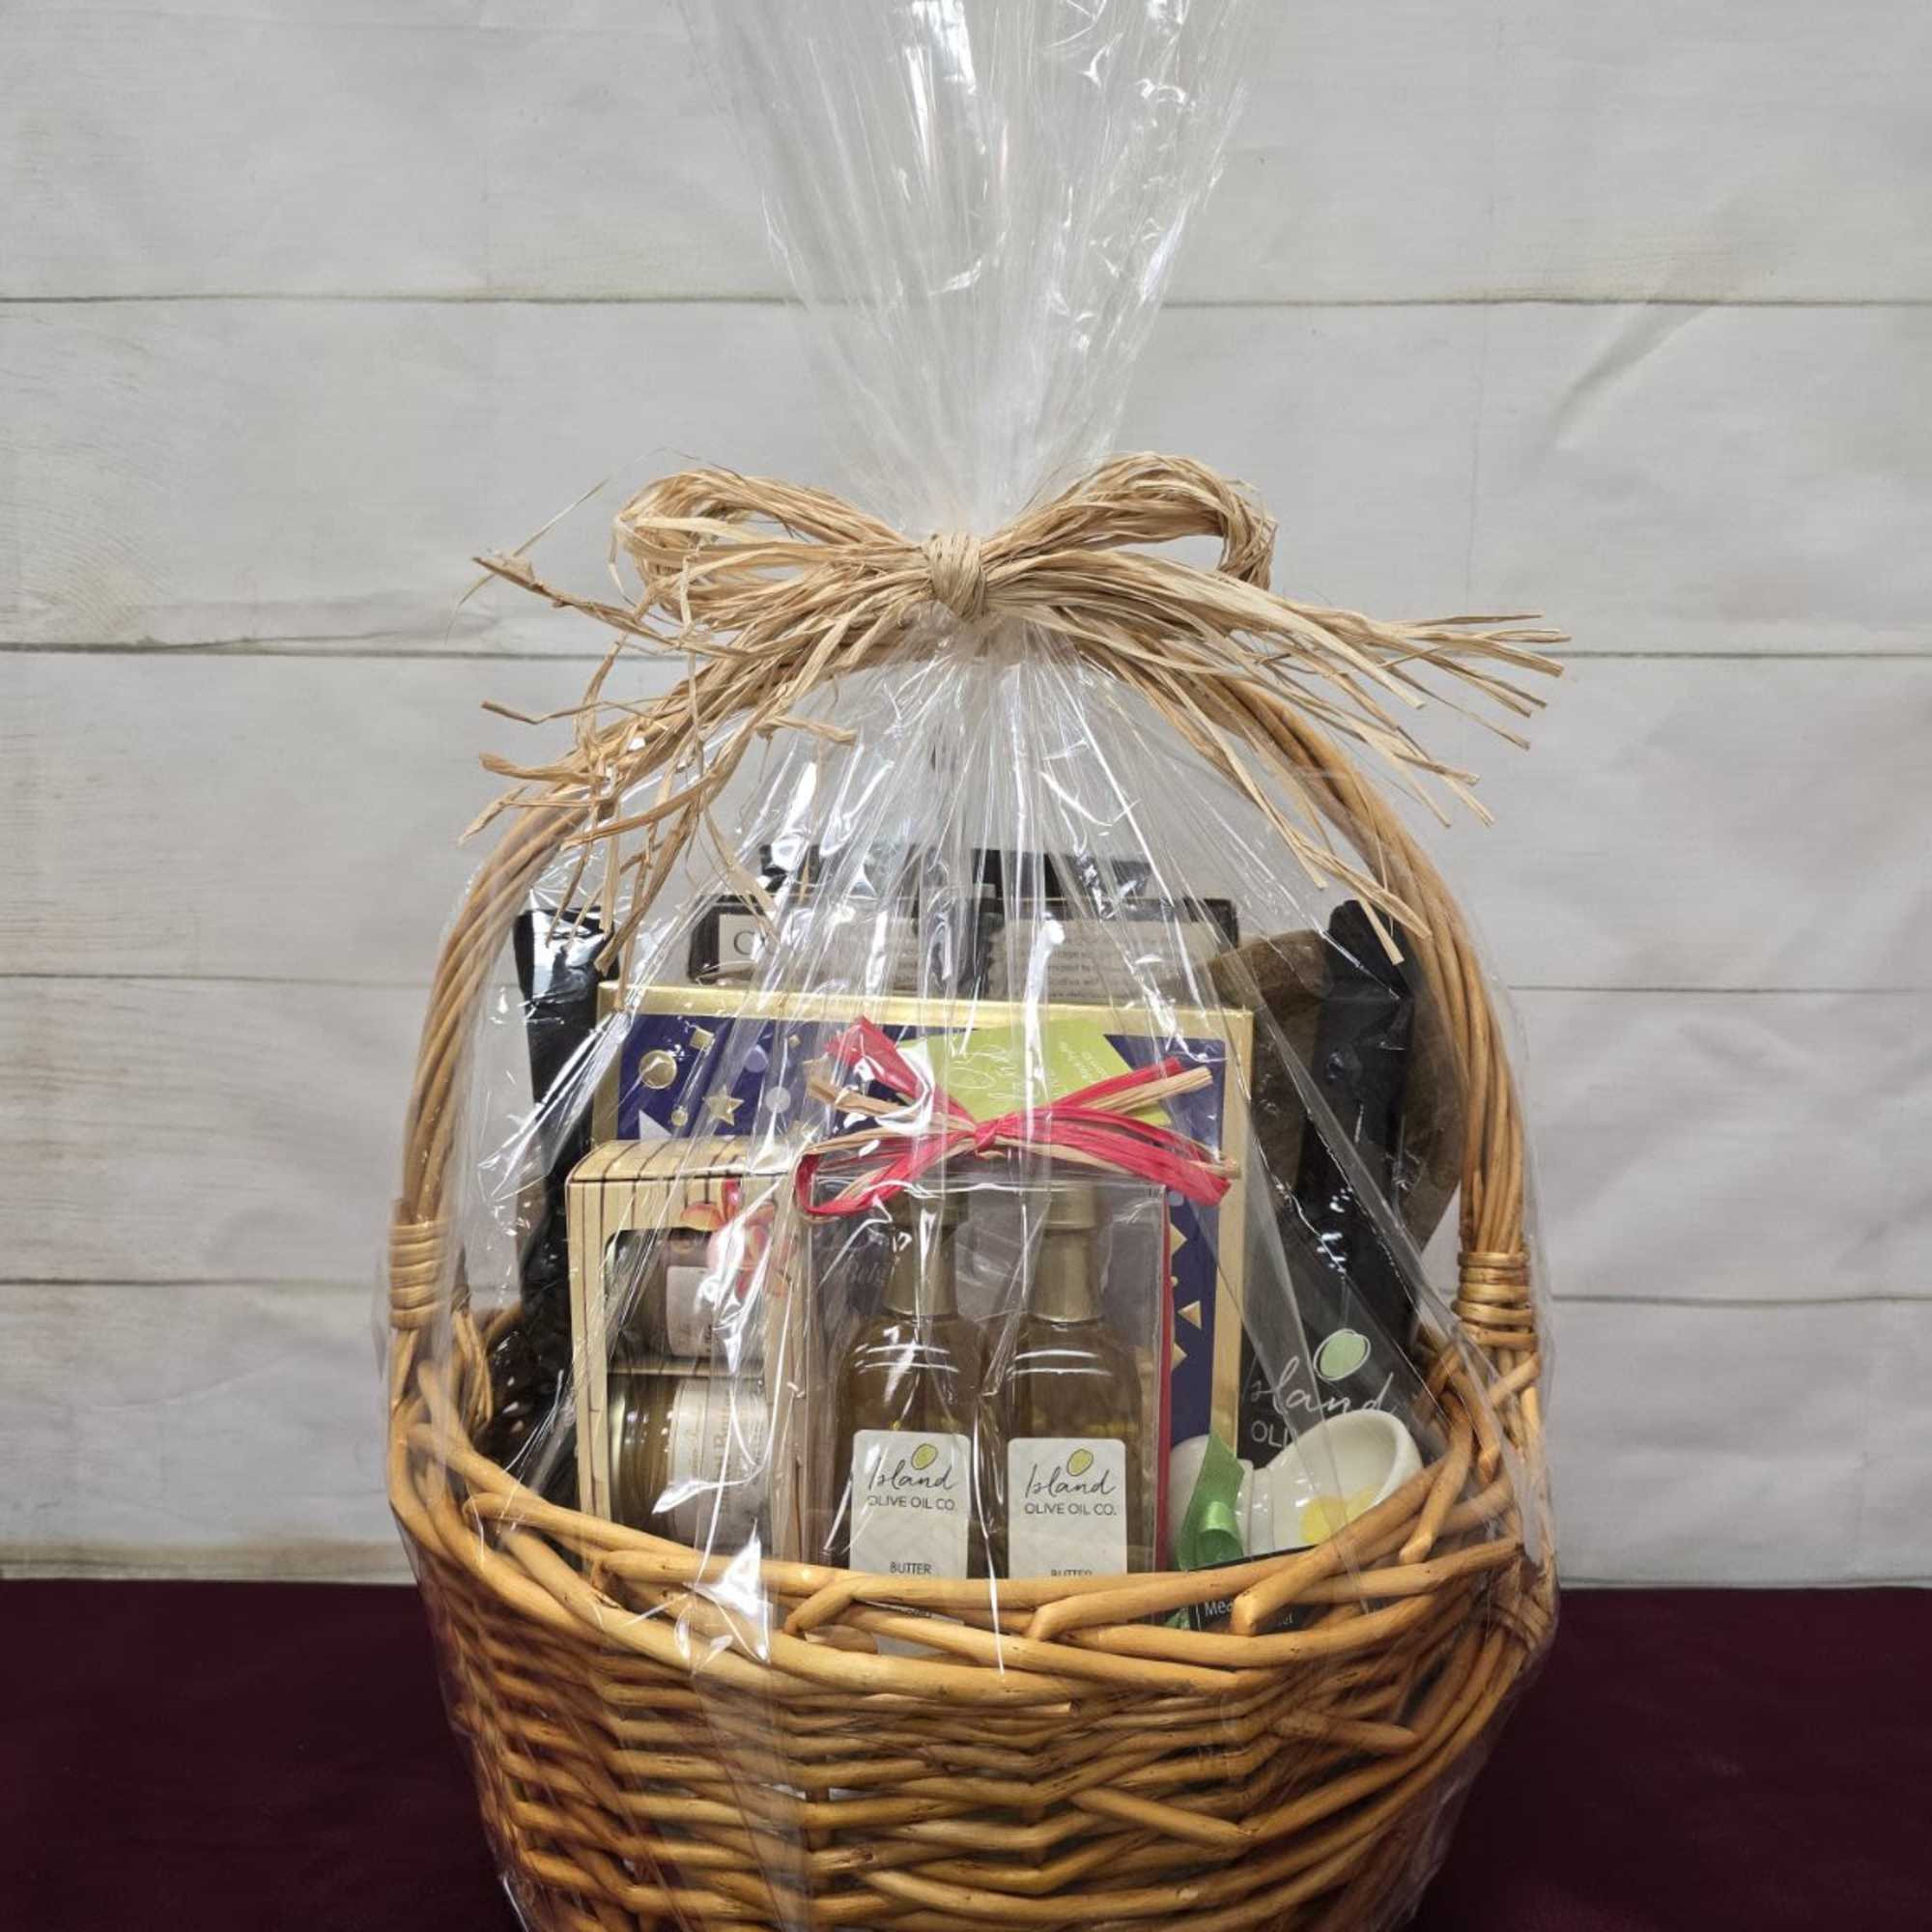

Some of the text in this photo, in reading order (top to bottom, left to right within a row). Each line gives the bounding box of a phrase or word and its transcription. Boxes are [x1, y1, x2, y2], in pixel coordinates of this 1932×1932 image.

[1251, 1355, 1397, 1414] sland
[867, 1456, 957, 1491] Island
[1024, 1463, 1117, 1498] Island
[867, 1494, 906, 1508] OLIVE
[910, 1496, 933, 1509] OIL
[1024, 1502, 1117, 1516] OLIVE OIL CO.
[889, 1561, 932, 1576] BUTTER
